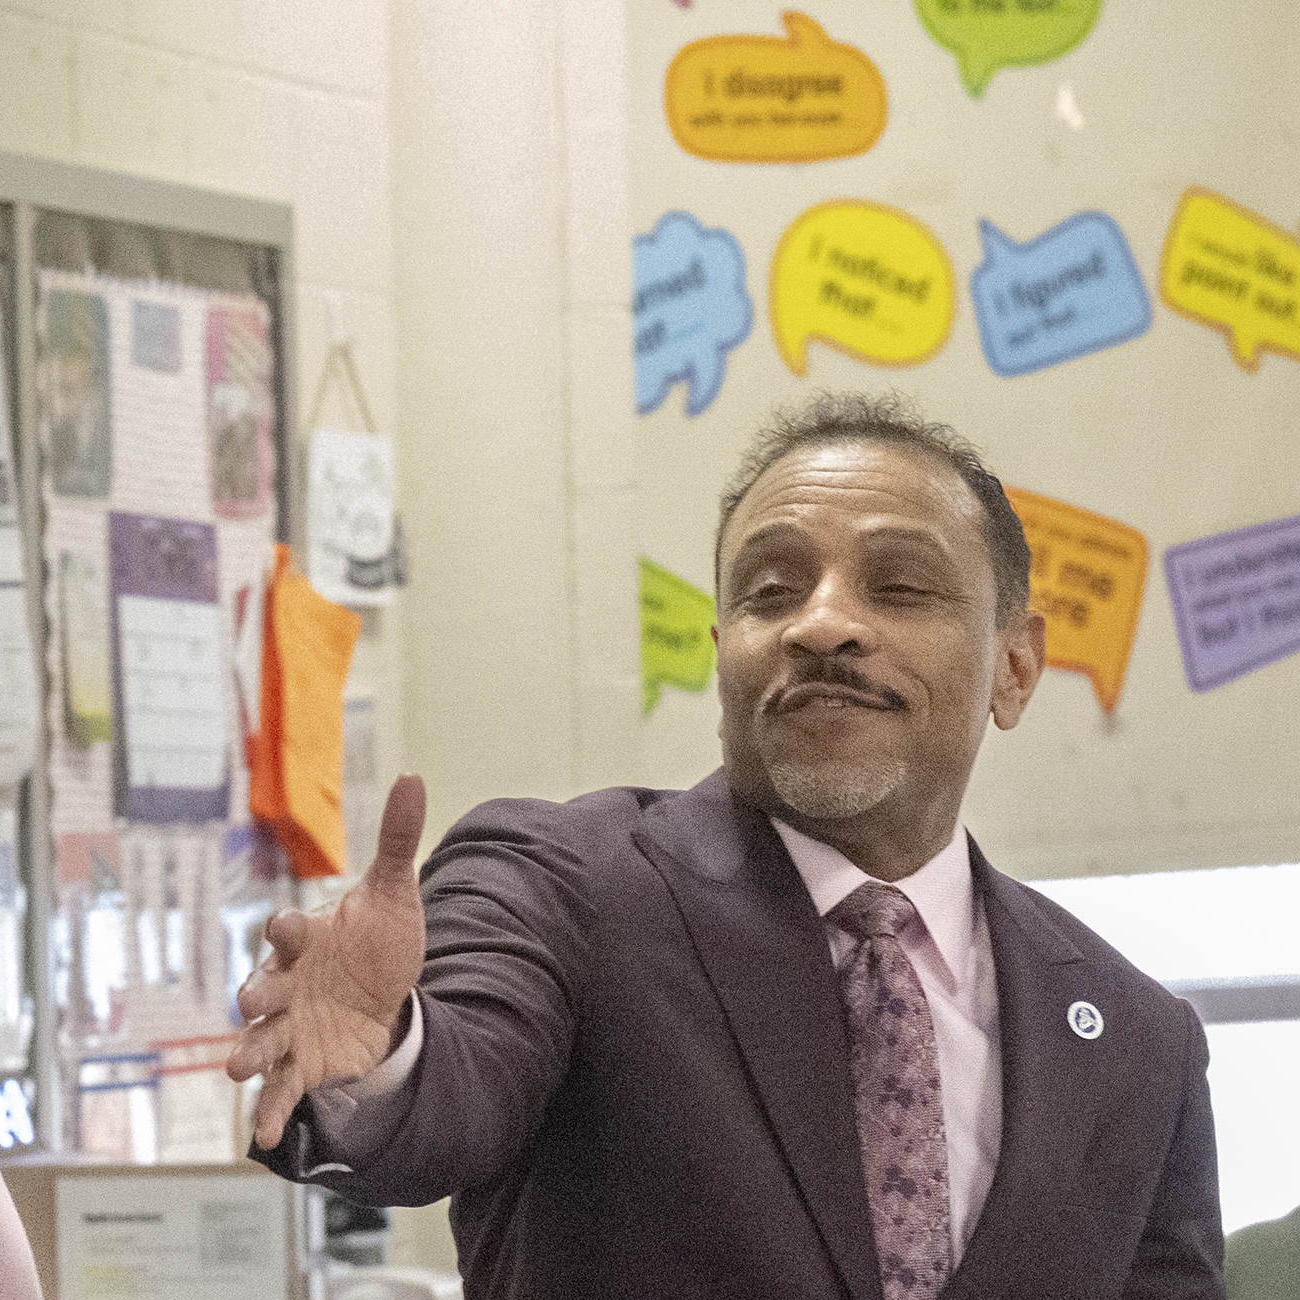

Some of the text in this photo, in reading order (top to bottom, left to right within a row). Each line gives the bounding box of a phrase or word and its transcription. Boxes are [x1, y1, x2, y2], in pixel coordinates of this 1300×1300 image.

[723, 69, 845, 102] disagree
[827, 250, 932, 305] noticed
[1011, 250, 1106, 311] figured
[1179, 260, 1249, 294] point
[1197, 616, 1240, 648] but
